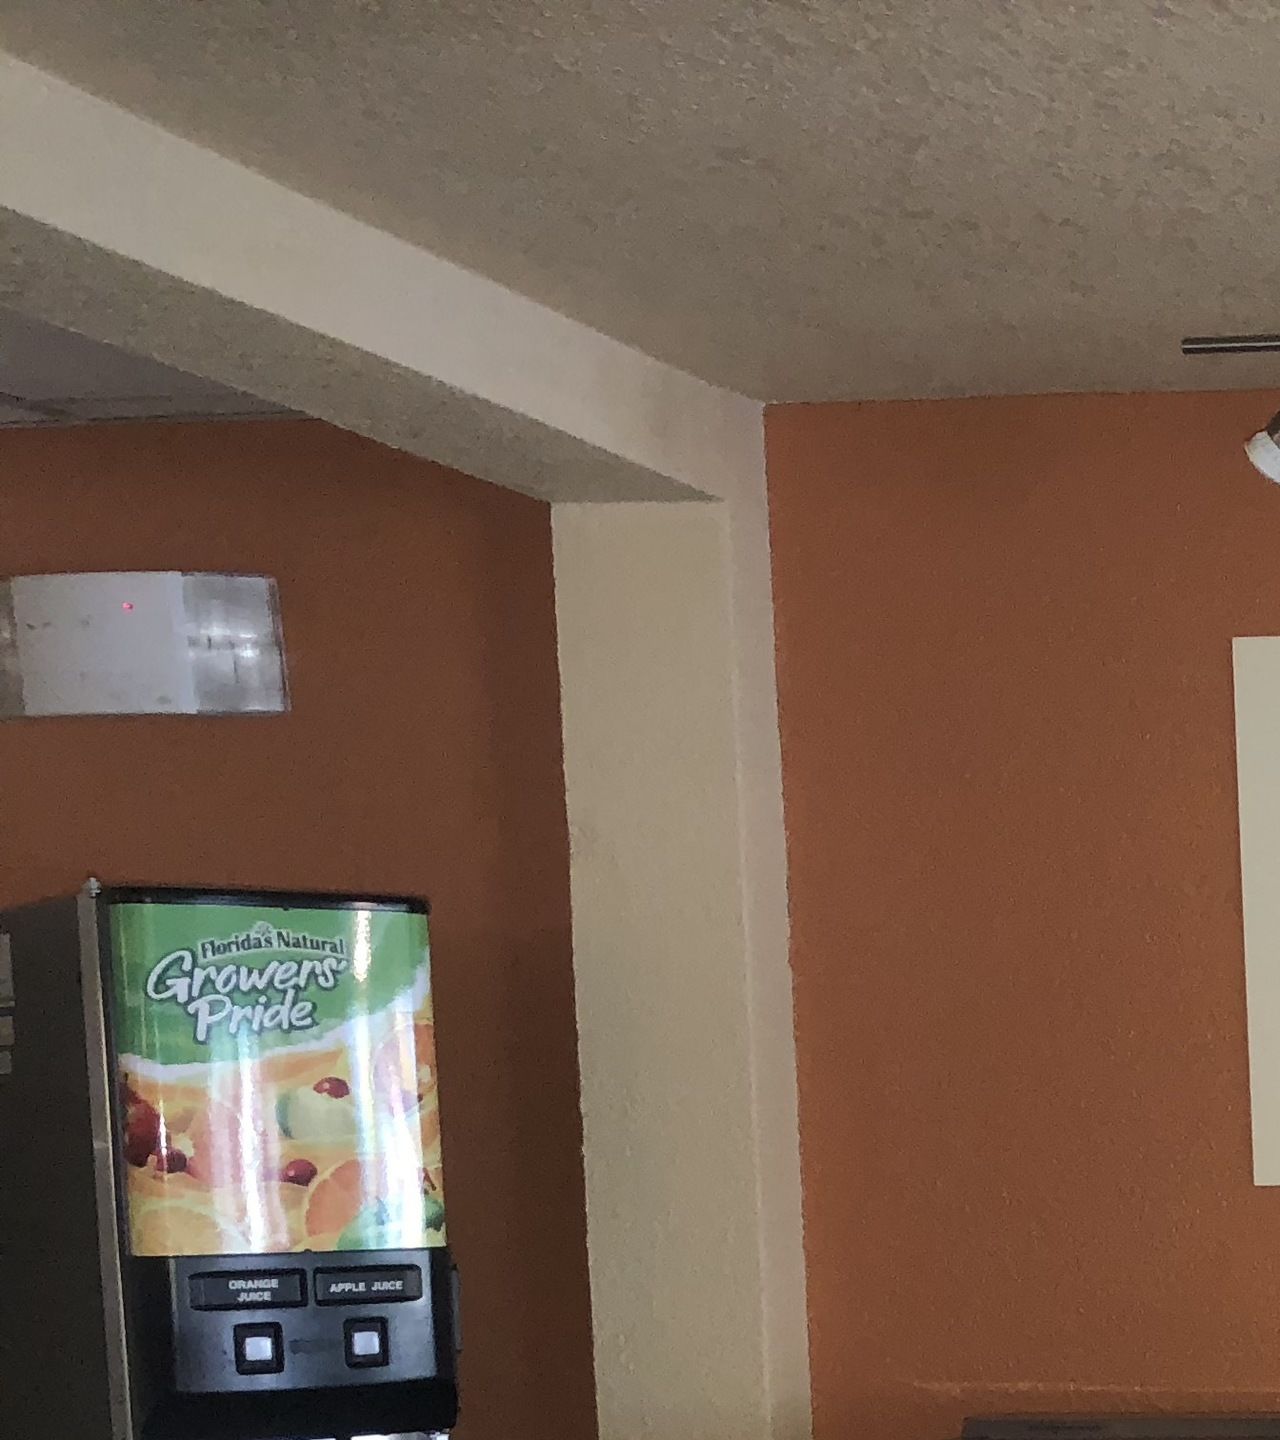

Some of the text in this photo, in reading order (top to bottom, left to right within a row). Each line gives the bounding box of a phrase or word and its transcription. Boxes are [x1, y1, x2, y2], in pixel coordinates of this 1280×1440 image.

[276, 930, 345, 955] Natural
[187, 988, 313, 1042] Pride
[228, 1278, 279, 1290] ORANGE
[329, 1280, 404, 1293] APPLE JUICE
[237, 1291, 272, 1301] JUICE
